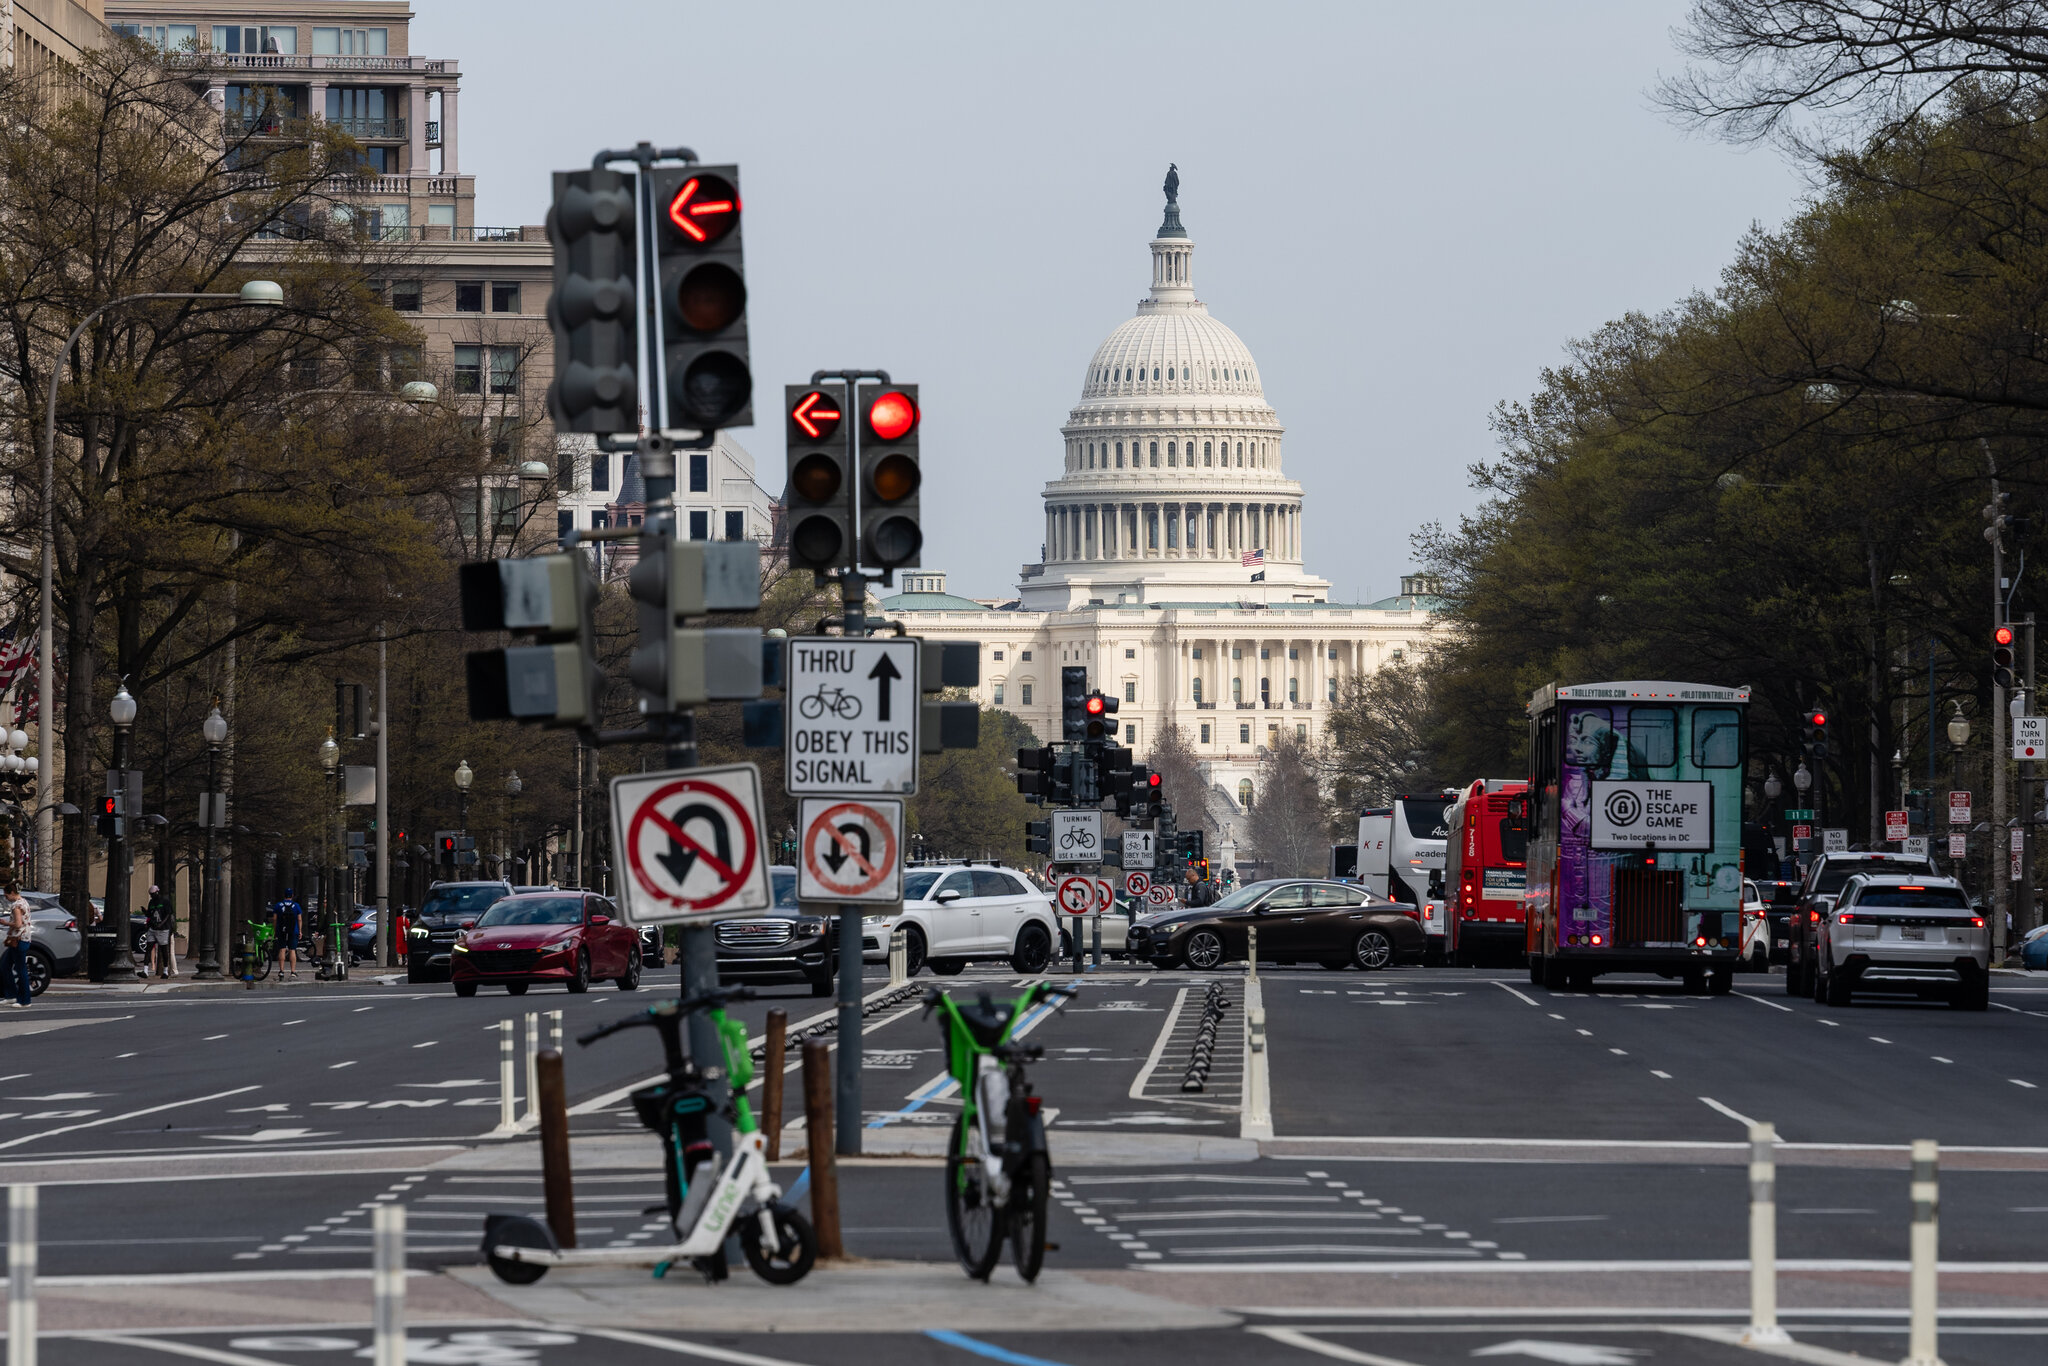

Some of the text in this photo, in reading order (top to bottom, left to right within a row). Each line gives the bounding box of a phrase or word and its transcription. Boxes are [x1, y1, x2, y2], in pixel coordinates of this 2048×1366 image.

[798, 649, 854, 674] THRU
[1571, 688, 1627, 698] TROLLEYTOURS.COM
[1680, 691, 1735, 700] #OLDTOWNTROLLEY
[2023, 721, 2037, 729] NO
[795, 730, 909, 754] OBEY THIS
[795, 760, 872, 784] SIGNAL
[1646, 789, 1672, 800] THE
[1646, 803, 1698, 814] ESCAPE
[1792, 811, 1799, 819] 11
[1646, 817, 1684, 828] GAME
[1611, 833, 1628, 841] Two
[1630, 833, 1666, 841] locations
[740, 925, 768, 933] GMC
